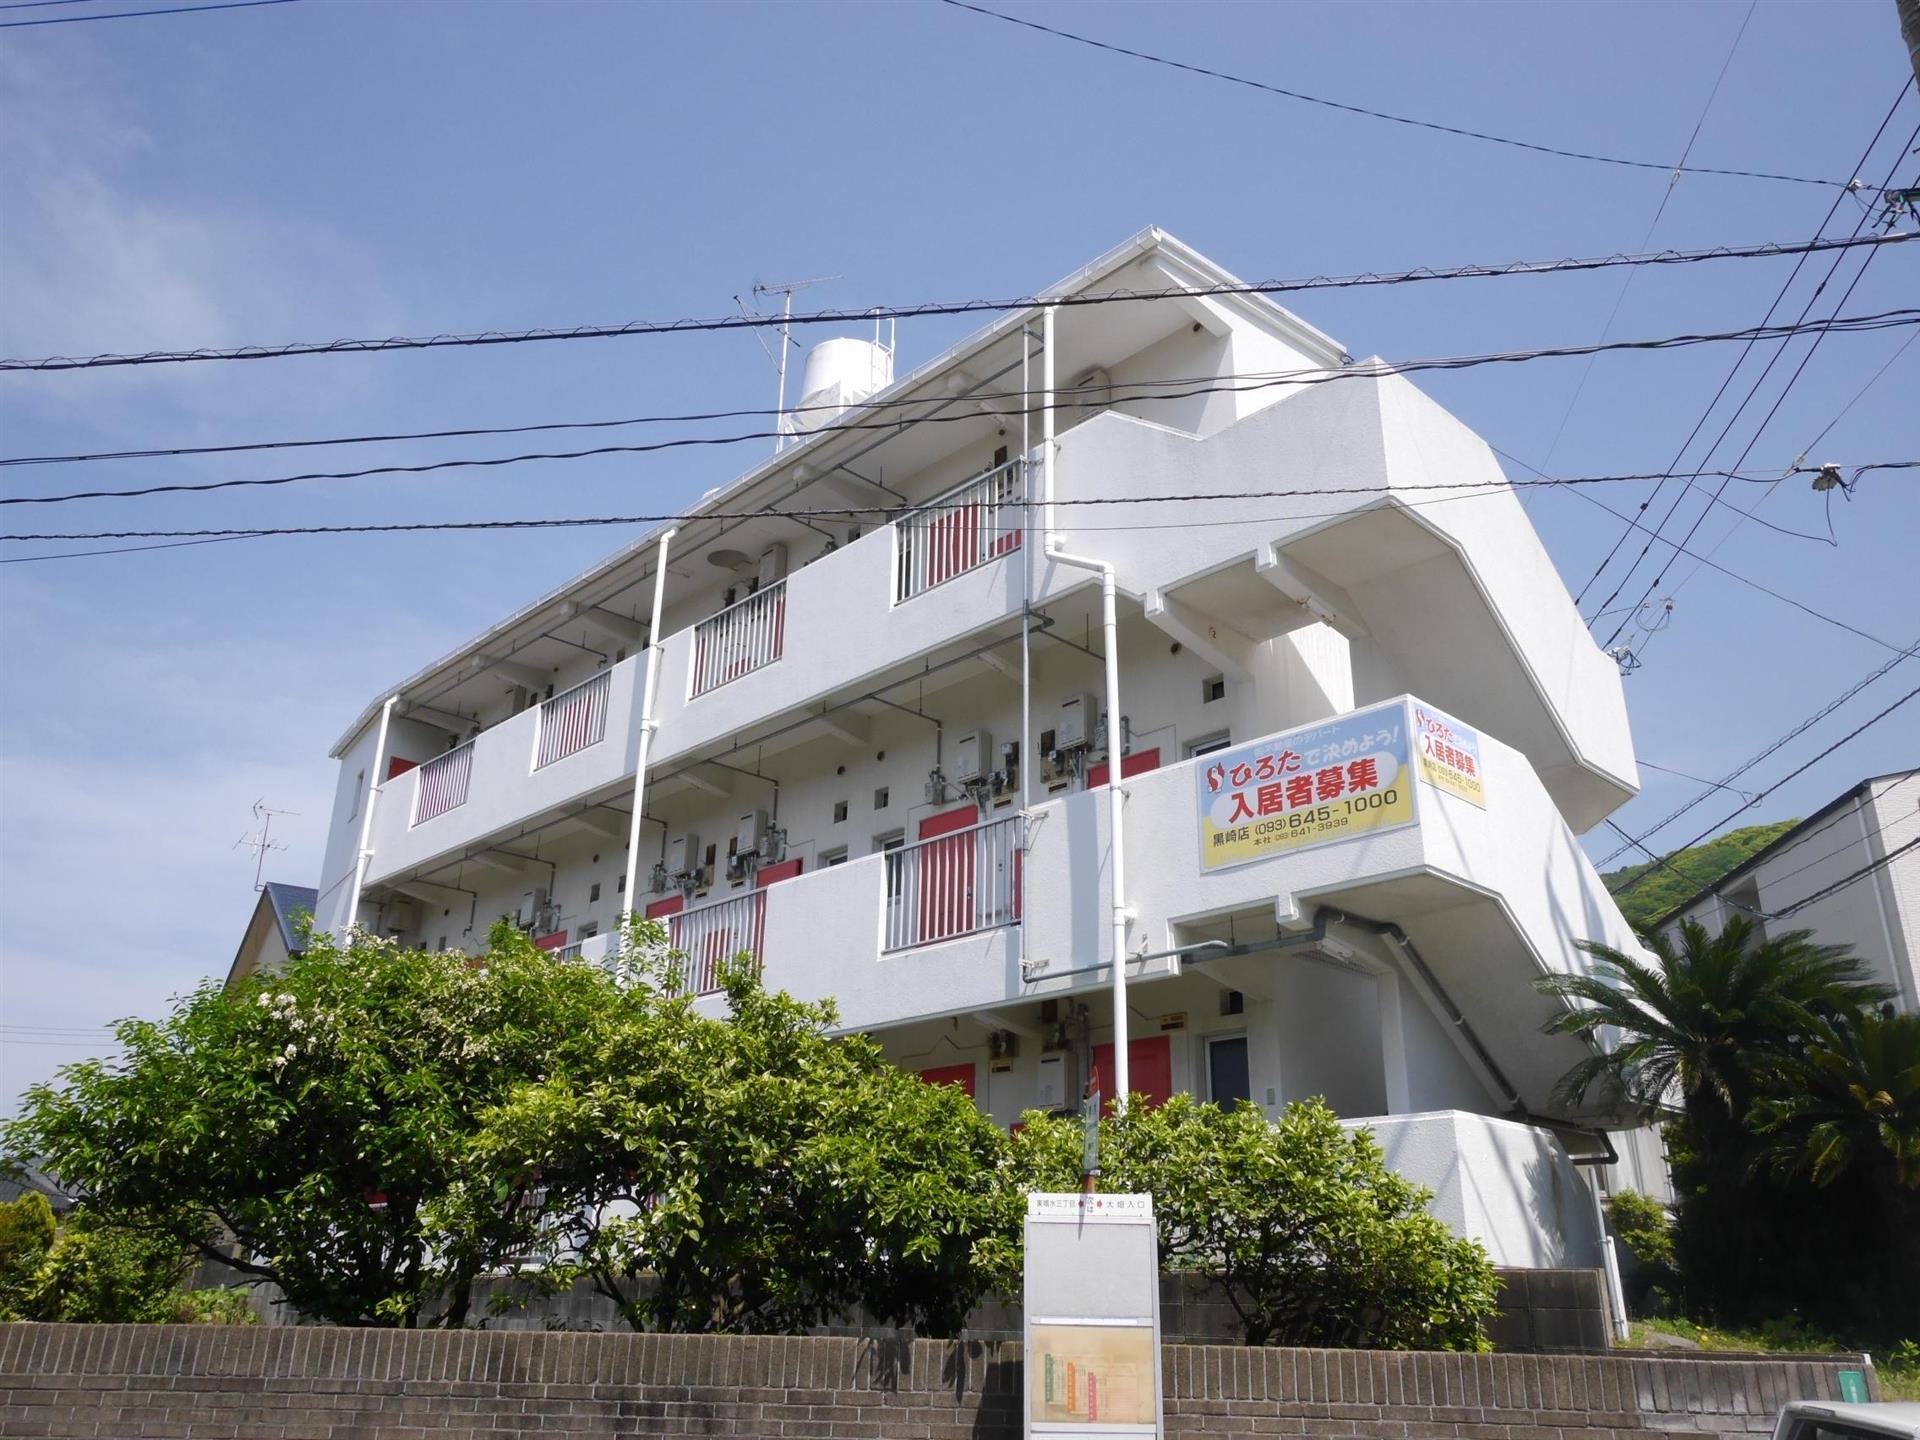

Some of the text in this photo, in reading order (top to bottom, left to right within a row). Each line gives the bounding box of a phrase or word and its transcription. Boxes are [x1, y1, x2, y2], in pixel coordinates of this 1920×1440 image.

[1229, 750, 1301, 787] ひろた
[1425, 735, 1476, 777] 入居者募集
[1228, 758, 1379, 824] 入居者募集
[1213, 827, 1250, 847] 黒崎店
